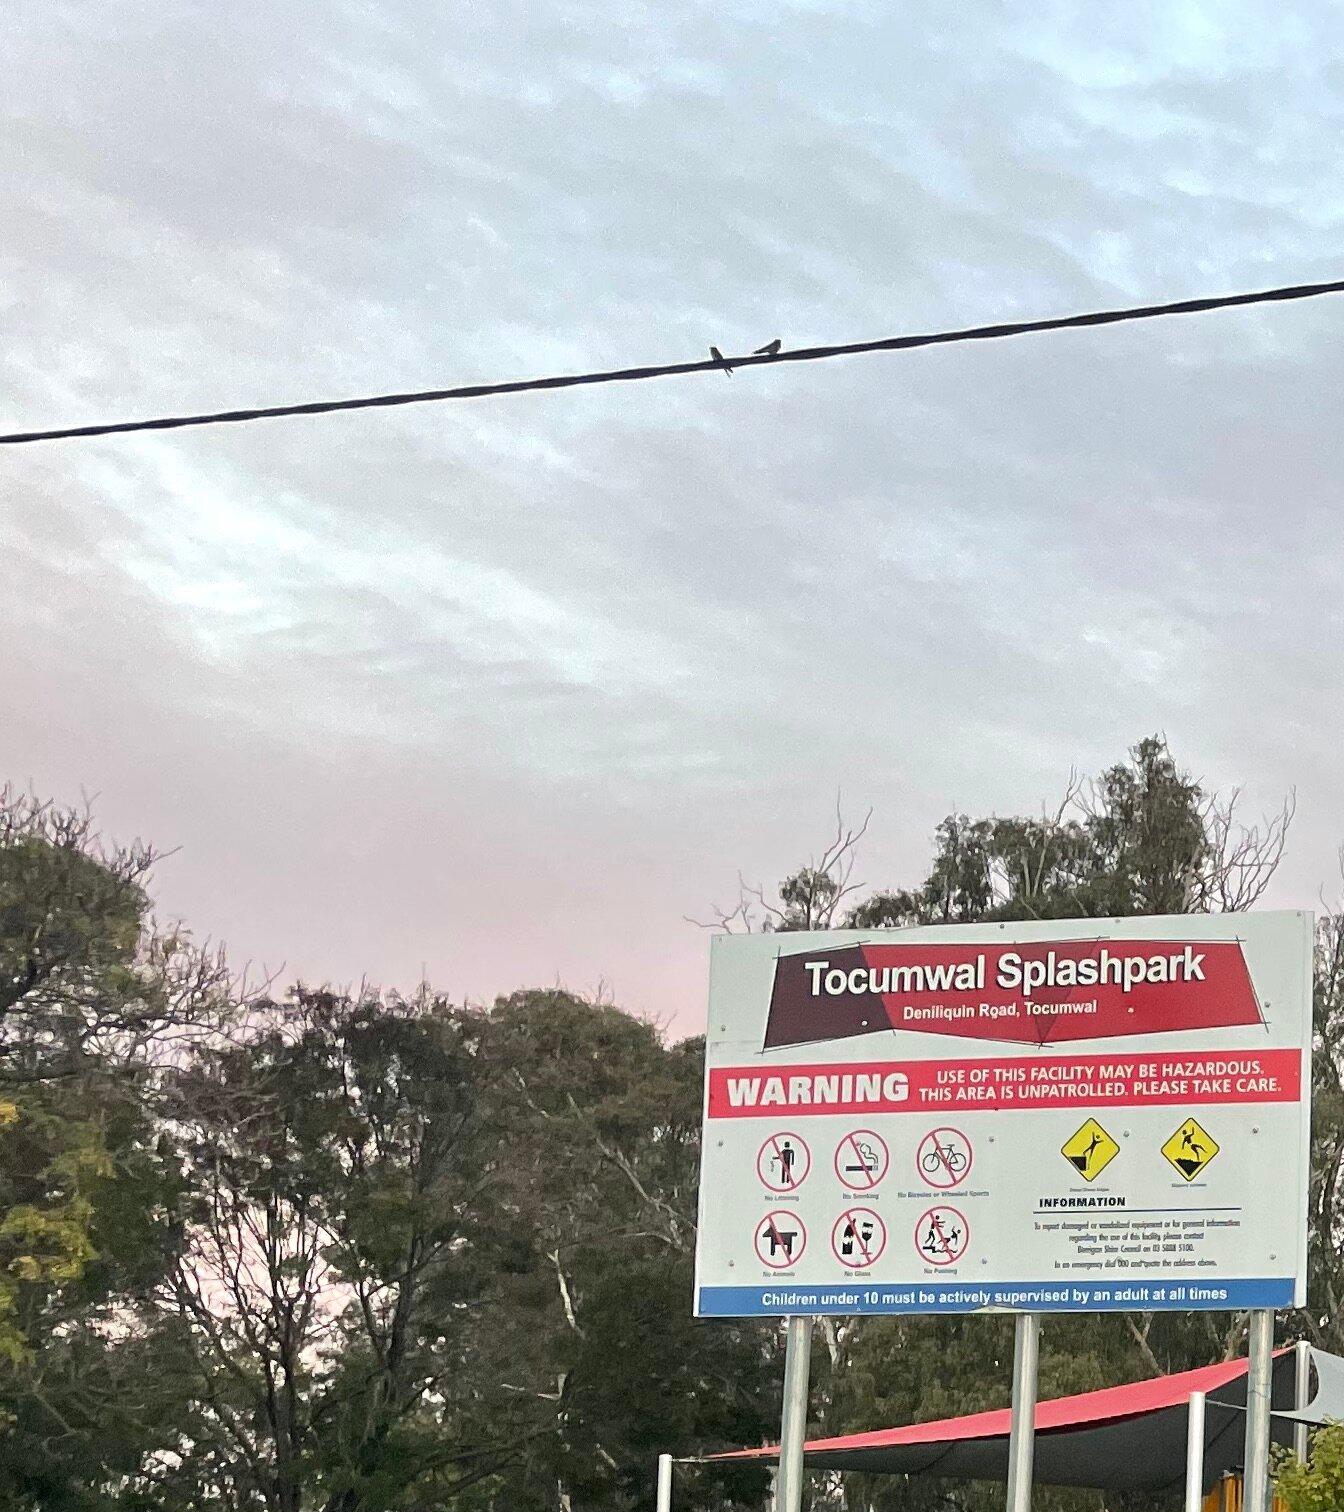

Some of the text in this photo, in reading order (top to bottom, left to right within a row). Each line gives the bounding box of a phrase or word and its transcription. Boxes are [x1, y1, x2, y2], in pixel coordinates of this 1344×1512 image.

[804, 945, 1207, 996] Tocumwal Splashpark
[903, 1000, 1097, 1021] Deniliquin Road, Tocumwal
[937, 1060, 1265, 1084] USE OF THIS FACILITY MAY BE HAZARDOUS.
[726, 1073, 909, 1107] WARNING
[918, 1077, 1281, 1102] THIS AREA IS UNPATROLLED. PLEASE TAKE CARE.
[1039, 1196, 1126, 1208] INFORMATION
[762, 1286, 1228, 1306] Children under 10 must be actively supervised by an adult at all times
